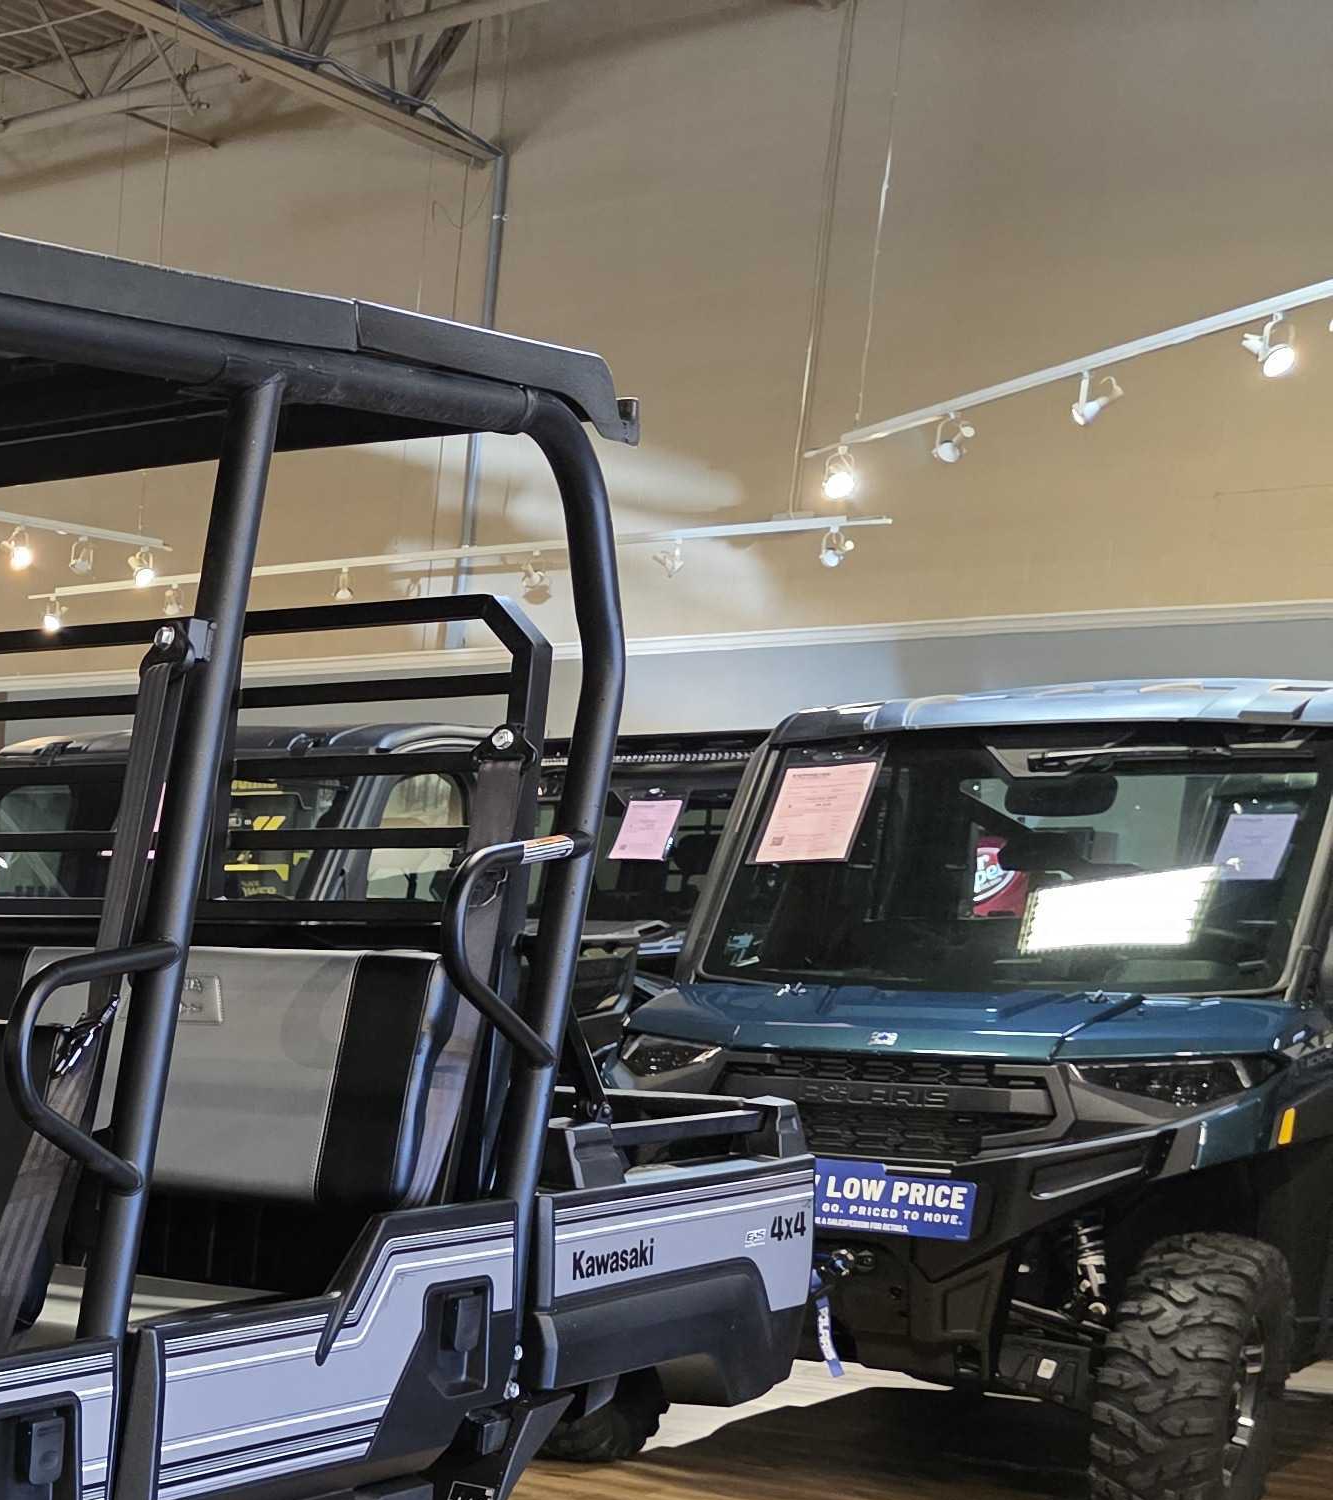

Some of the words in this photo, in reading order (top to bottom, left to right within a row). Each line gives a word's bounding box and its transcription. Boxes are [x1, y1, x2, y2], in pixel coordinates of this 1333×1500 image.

[801, 1082, 950, 1108] POLARIS
[826, 1175, 886, 1202] LOW
[891, 1181, 969, 1210] PRICE
[849, 1204, 898, 1219] PRICED
[903, 1210, 919, 1221] TO
[924, 1211, 964, 1226] MOVE.
[572, 1237, 655, 1281] Kawasaki
[770, 1211, 807, 1242] 4x4
